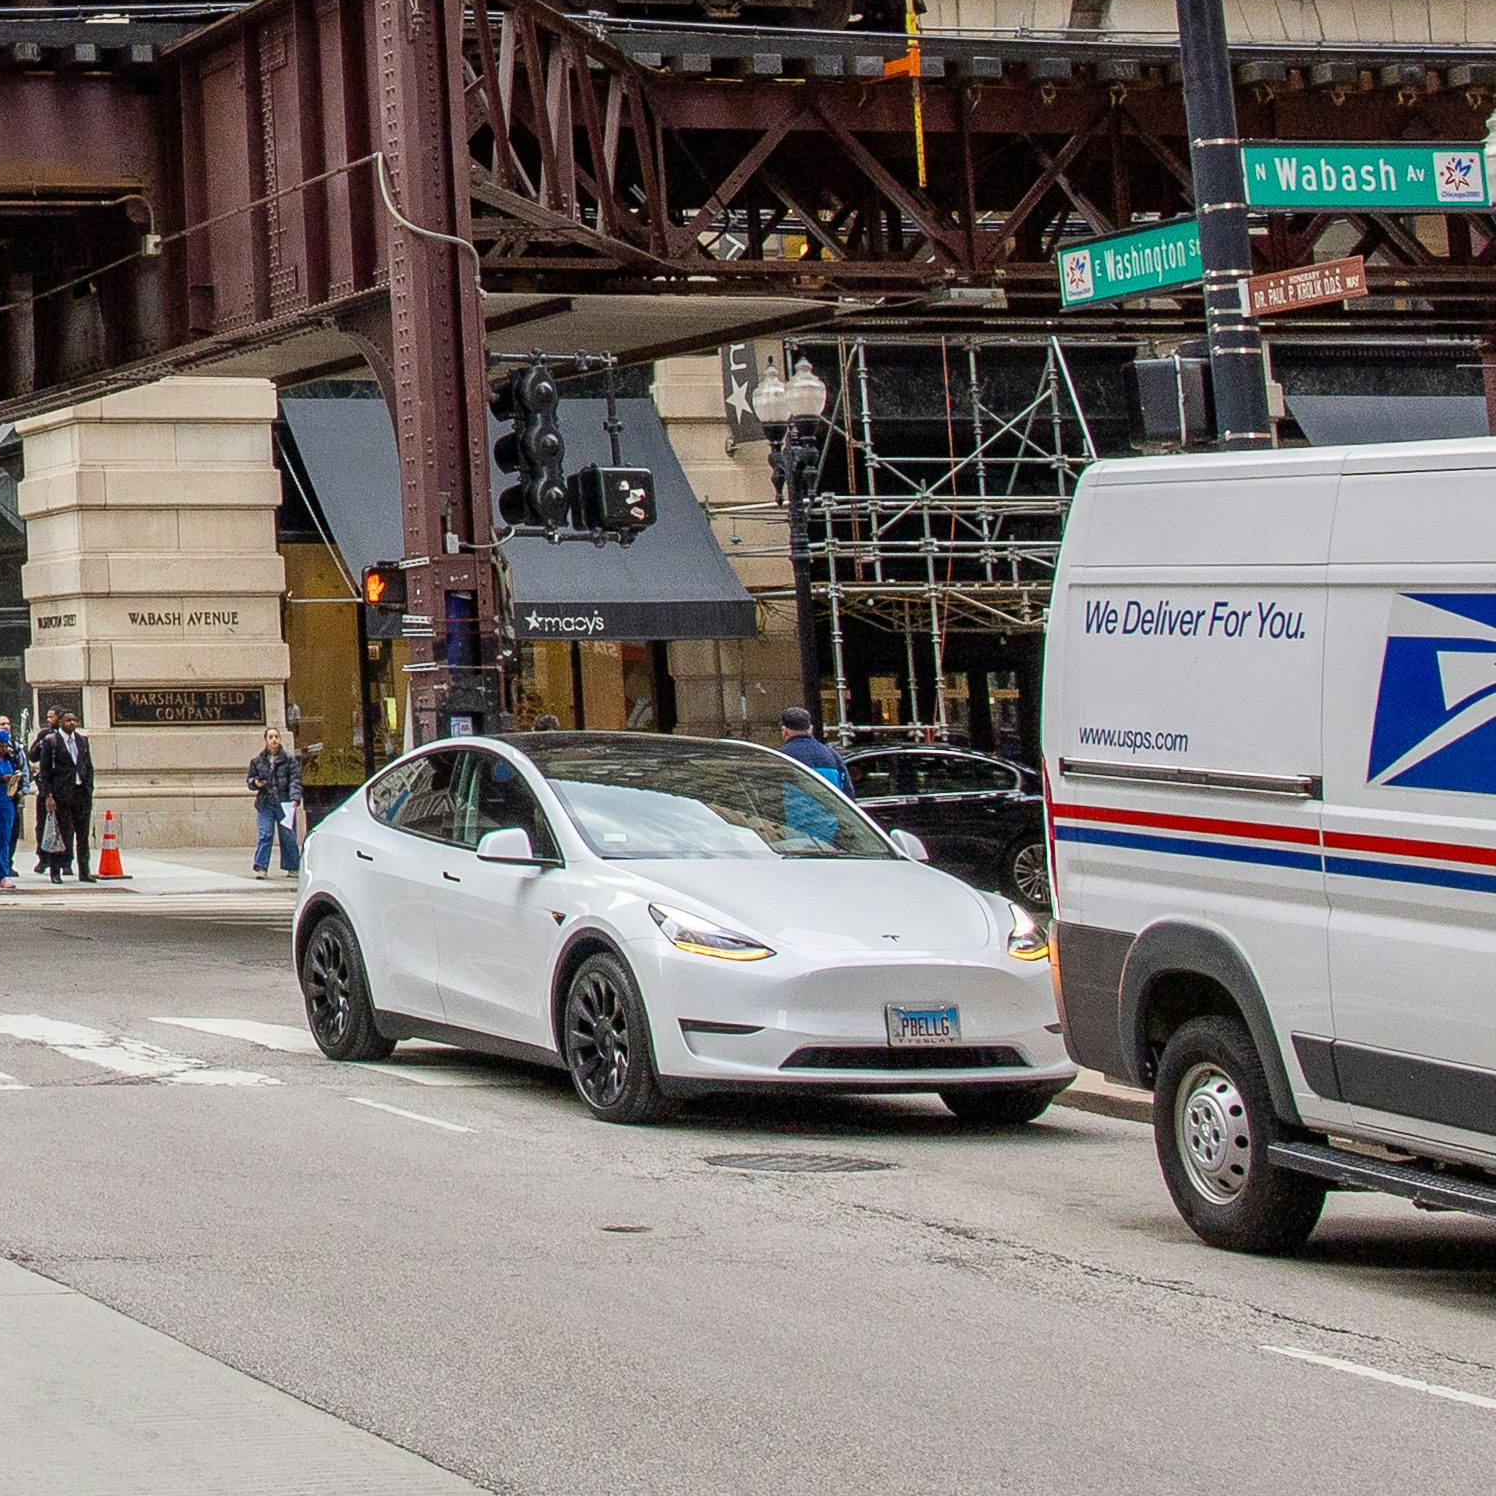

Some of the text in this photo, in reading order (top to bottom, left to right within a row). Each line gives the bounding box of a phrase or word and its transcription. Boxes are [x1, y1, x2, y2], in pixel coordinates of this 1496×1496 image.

[1255, 157, 1425, 192] N Wabash Av
[1095, 259, 1103, 277] E
[1103, 239, 1187, 284] Washington
[1269, 286, 1287, 306] PAUL
[1346, 275, 1361, 289] WAY
[128, 611, 239, 626] WABASH AVENUE
[1085, 600, 1305, 640] We Deliver For You.
[129, 692, 245, 705] MARSHALL FIELD
[155, 708, 224, 720] COMPANY
[1079, 727, 1188, 754] www.usps.com
